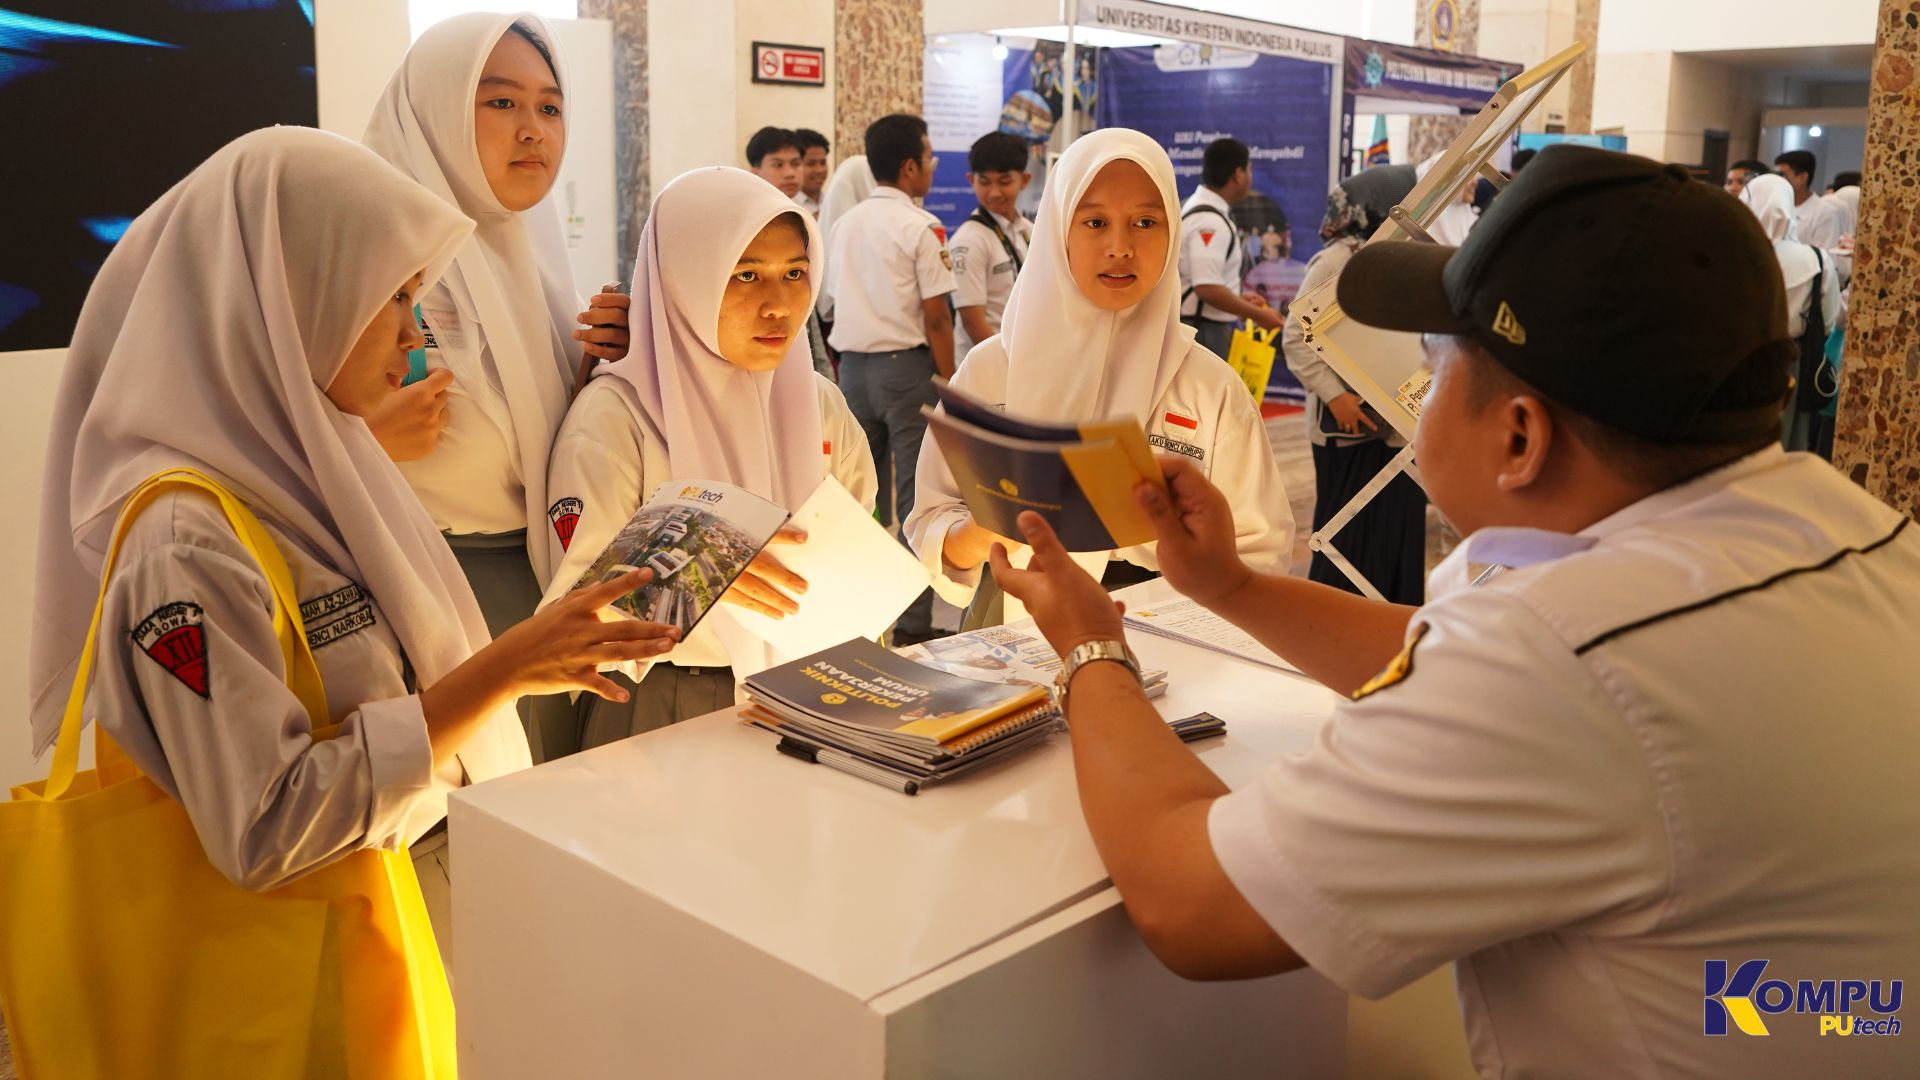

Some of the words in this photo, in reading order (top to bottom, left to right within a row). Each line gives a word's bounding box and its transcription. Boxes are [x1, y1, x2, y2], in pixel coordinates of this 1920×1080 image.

[1096, 5, 1181, 35] UNIVERSITAS
[1185, 20, 1232, 42] KRISTEN
[1235, 31, 1292, 50] INDONESIA
[1295, 41, 1332, 58] PAULUS
[138, 620, 156, 641] SMA
[154, 616, 188, 636] GOWA
[333, 610, 371, 635] NARKOBA
[799, 666, 902, 708] POLITEKNIK
[814, 661, 917, 702] PEKERJAAN
[872, 676, 929, 697] UMUM
